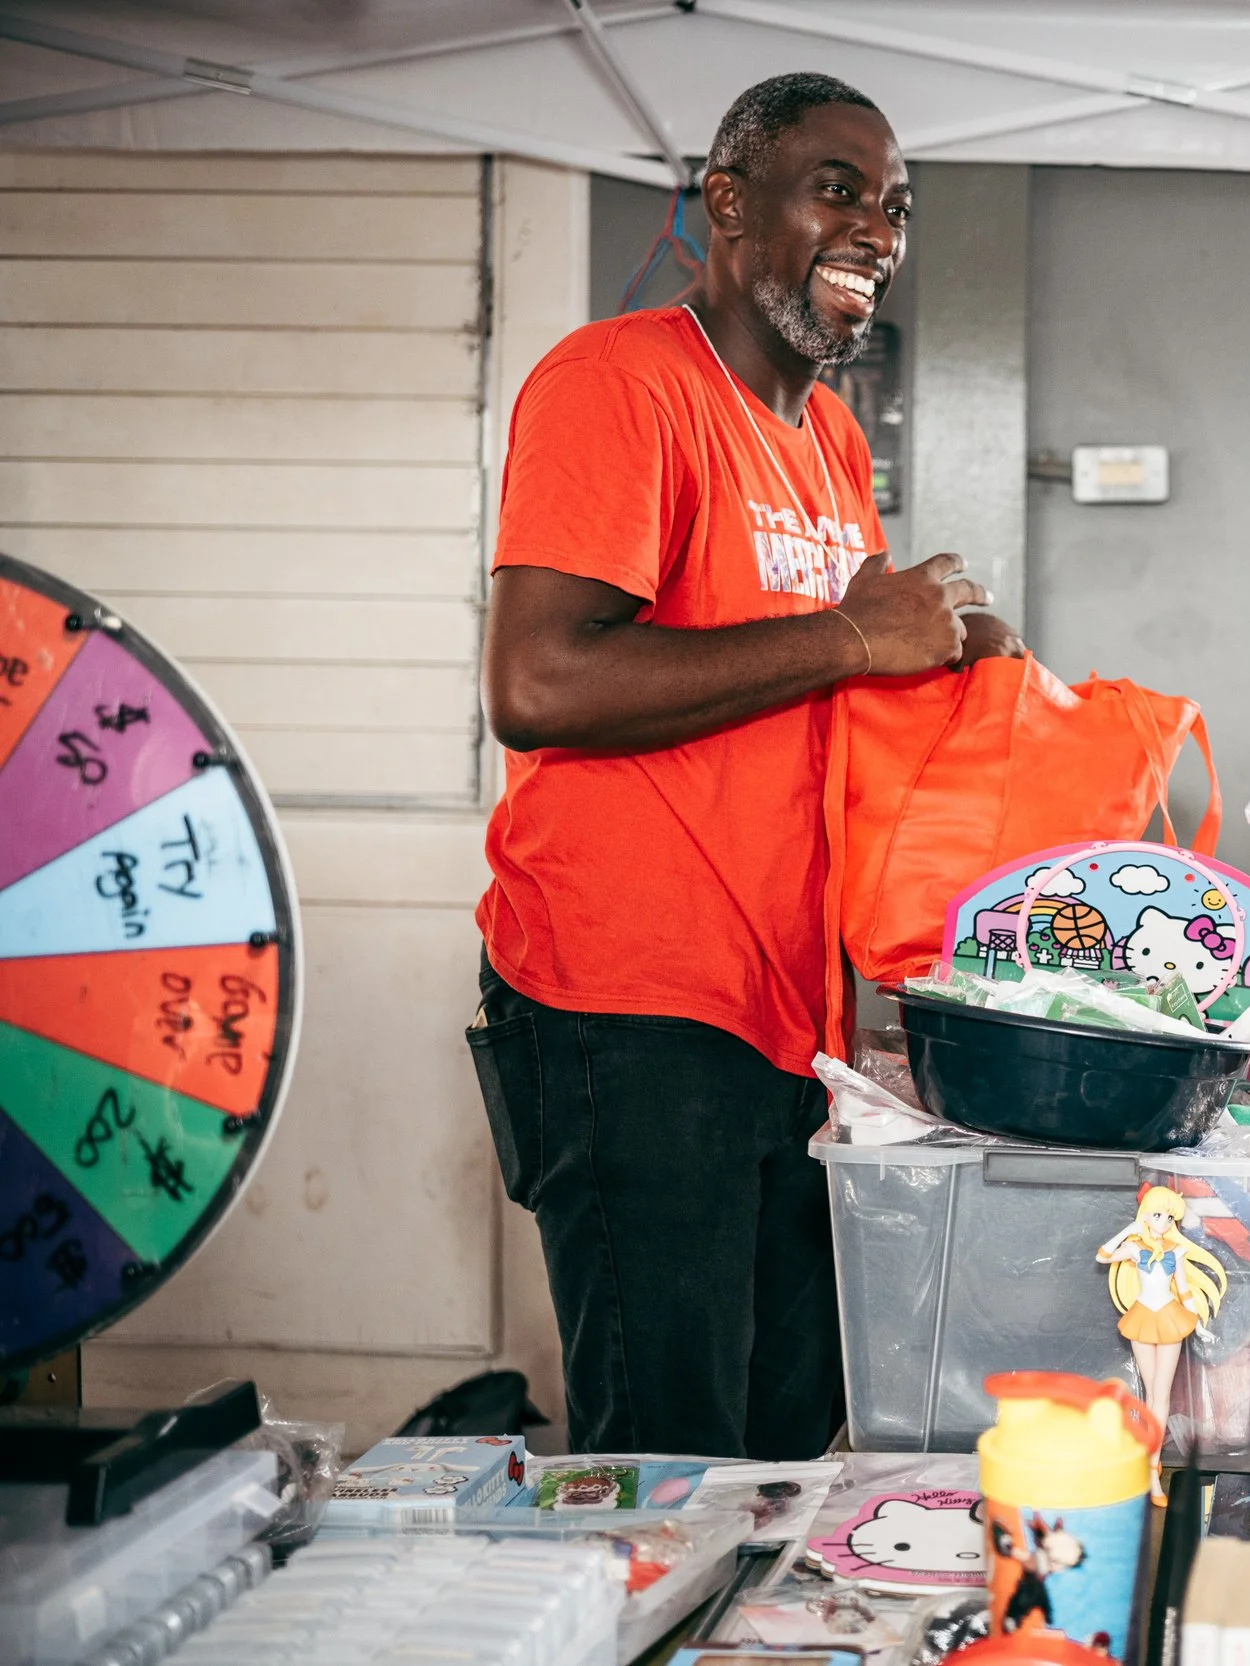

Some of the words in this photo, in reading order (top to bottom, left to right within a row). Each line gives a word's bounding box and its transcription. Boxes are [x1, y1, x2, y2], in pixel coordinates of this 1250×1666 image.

[748, 499, 802, 534] THE
[804, 515, 866, 549] ANME
[157, 814, 204, 901] Try
[74, 1087, 137, 1169] 200
